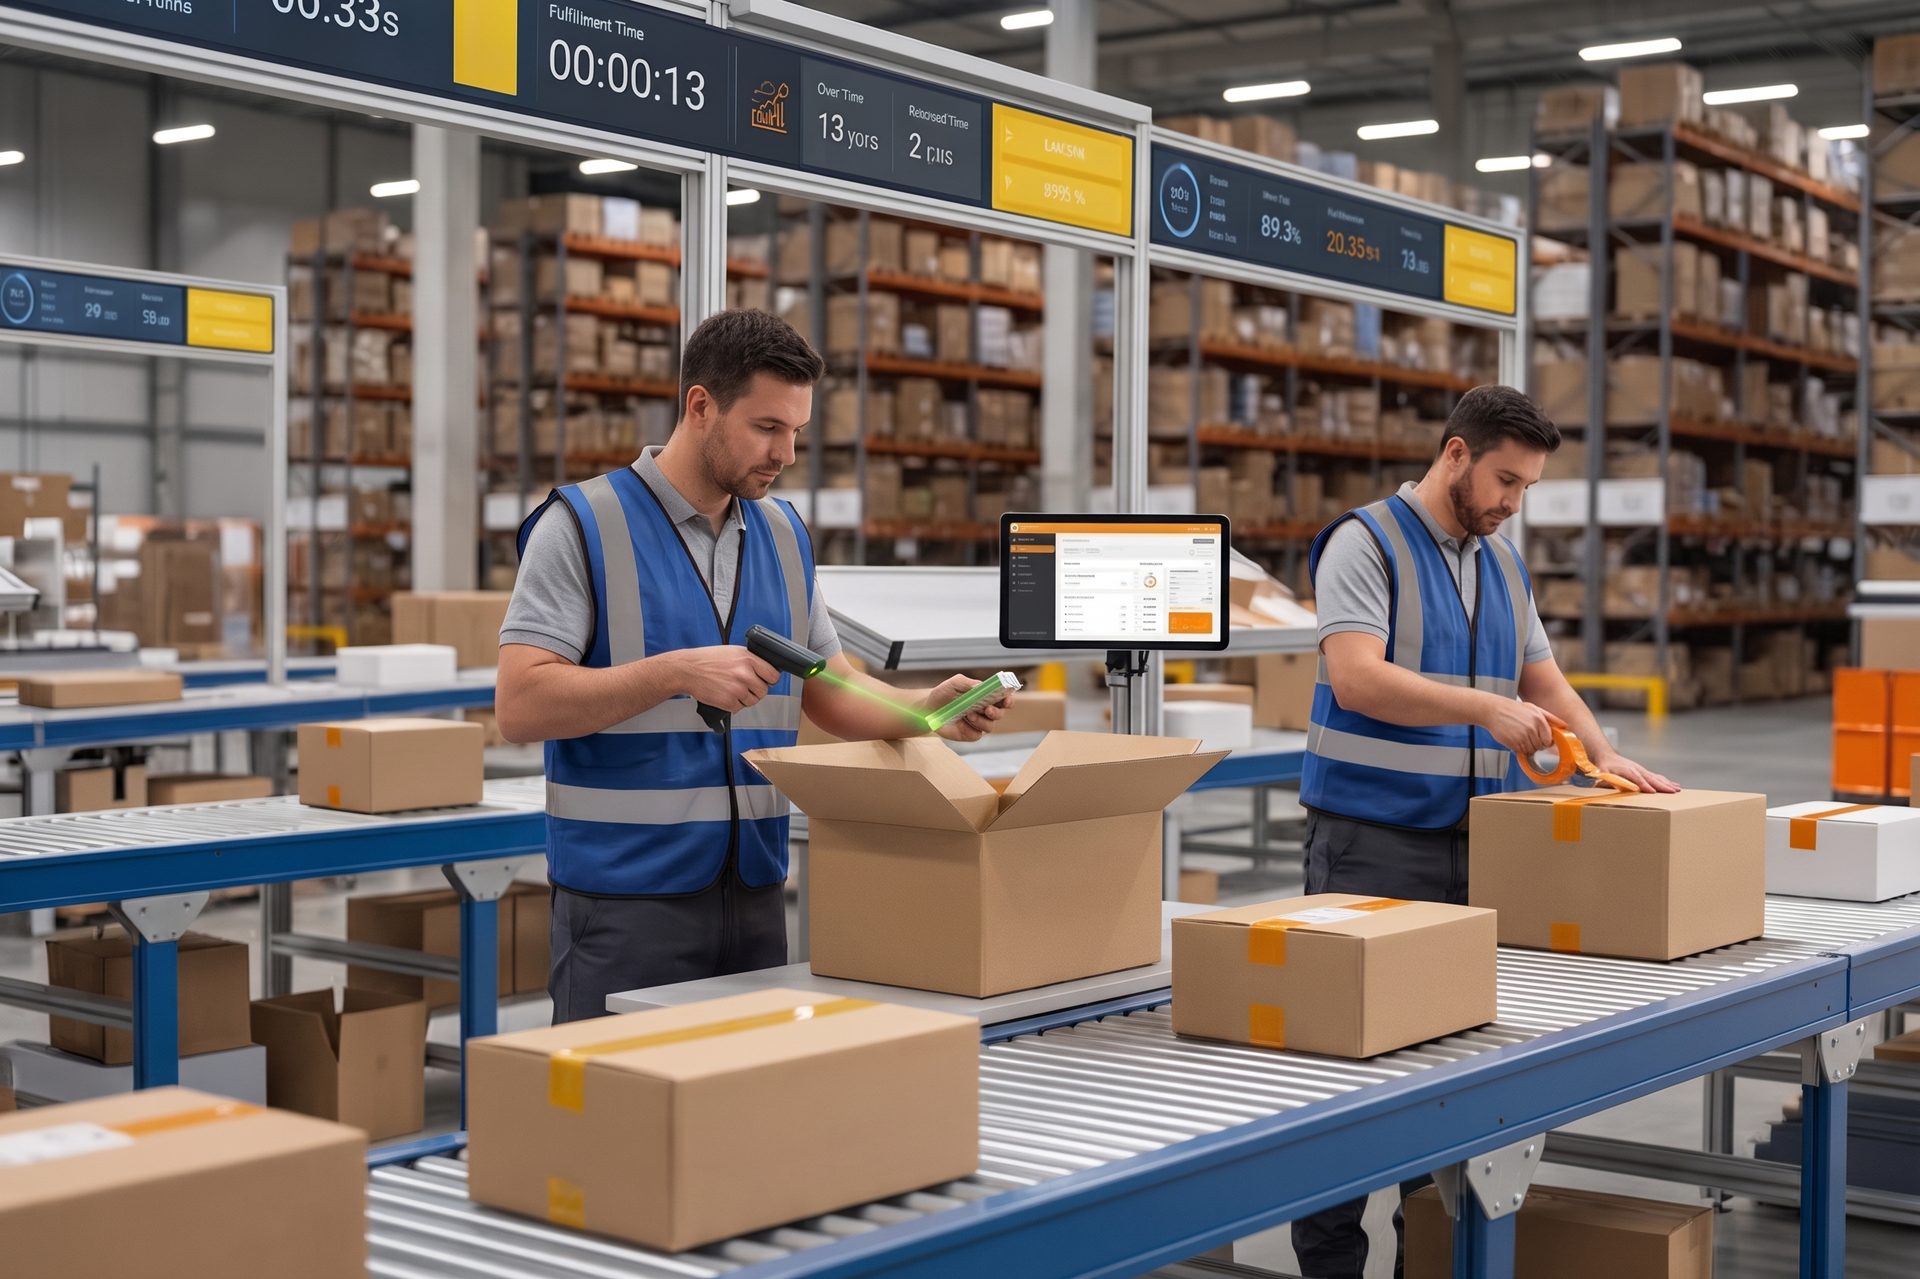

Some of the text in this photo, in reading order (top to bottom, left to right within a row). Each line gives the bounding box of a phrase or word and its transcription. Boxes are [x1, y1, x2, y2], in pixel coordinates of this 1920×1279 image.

[614, 20, 645, 41] Time
[549, 39, 705, 111] 00:00:13
[817, 82, 864, 104] Over Time
[818, 112, 879, 150] 13 yors
[947, 114, 969, 130] Time
[909, 132, 922, 159] 2
[1261, 214, 1302, 245] 89.3%
